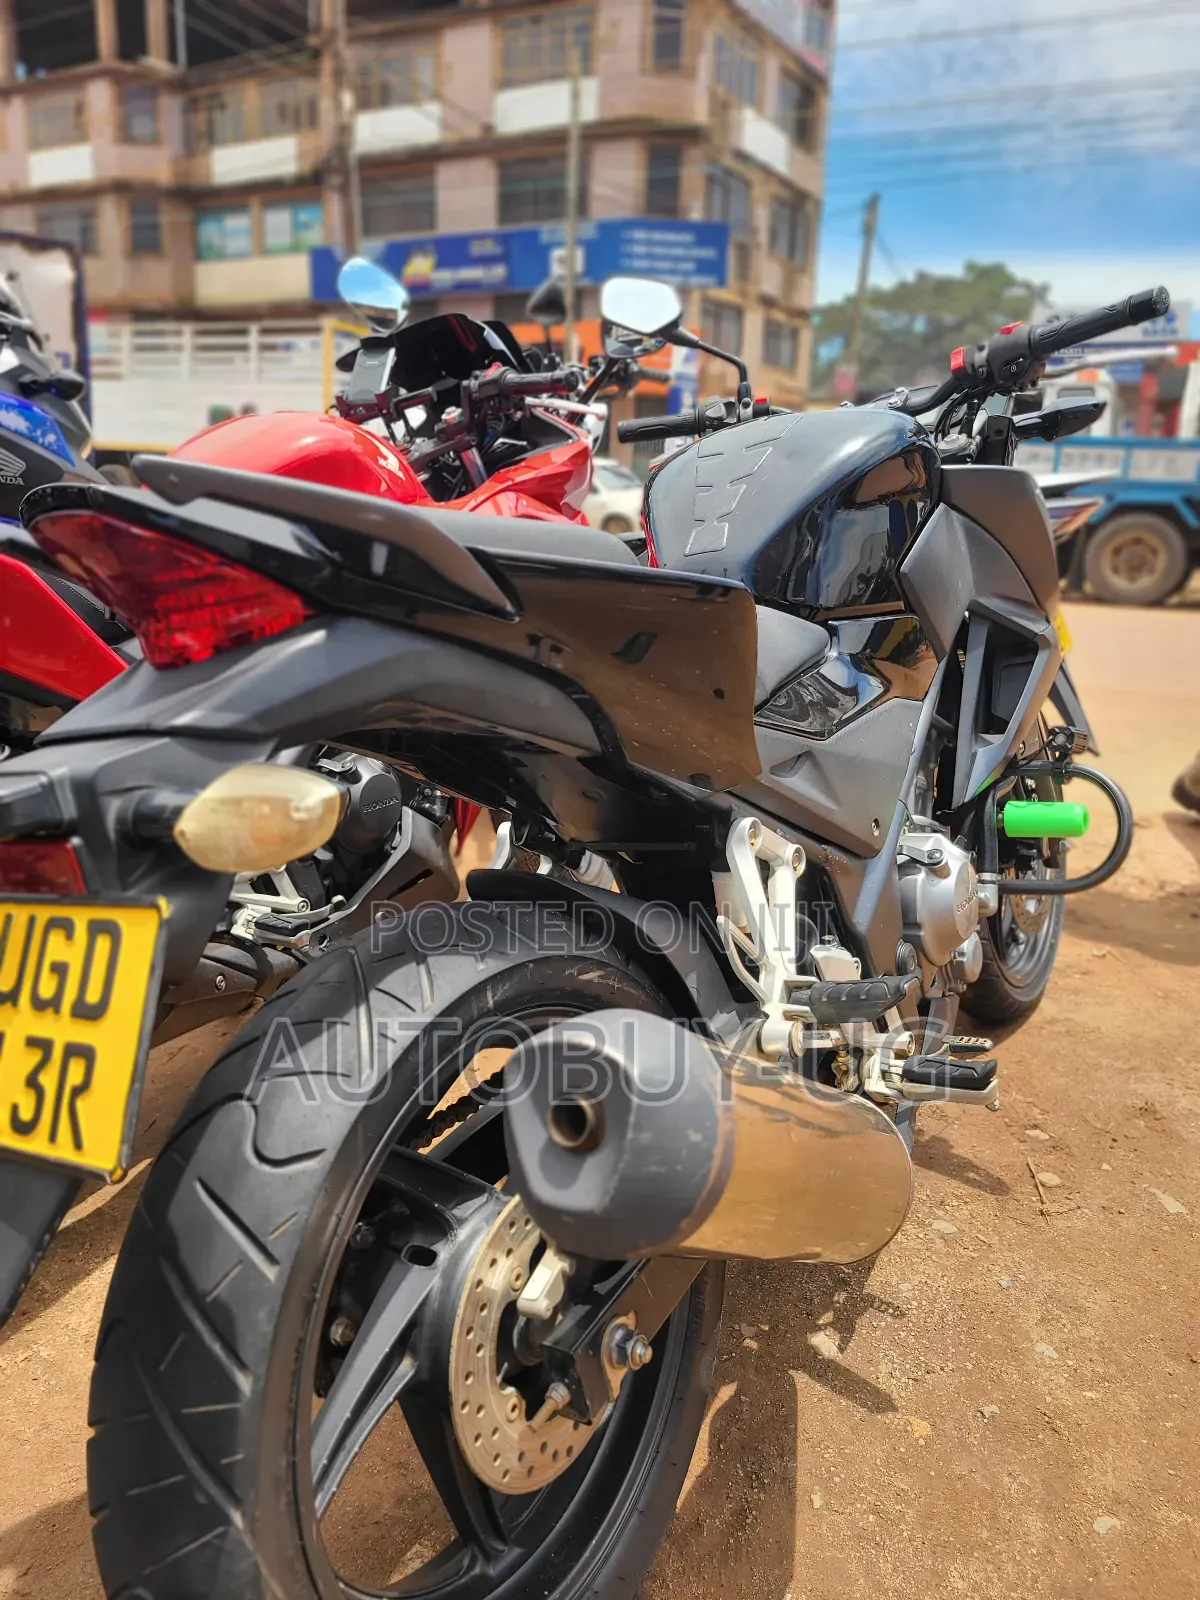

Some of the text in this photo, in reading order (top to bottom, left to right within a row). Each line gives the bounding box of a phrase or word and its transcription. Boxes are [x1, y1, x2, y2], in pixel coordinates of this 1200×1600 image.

[362, 796, 400, 813] HONDA
[0, 912, 123, 1021] UGD
[0, 1030, 97, 1151] 3R
